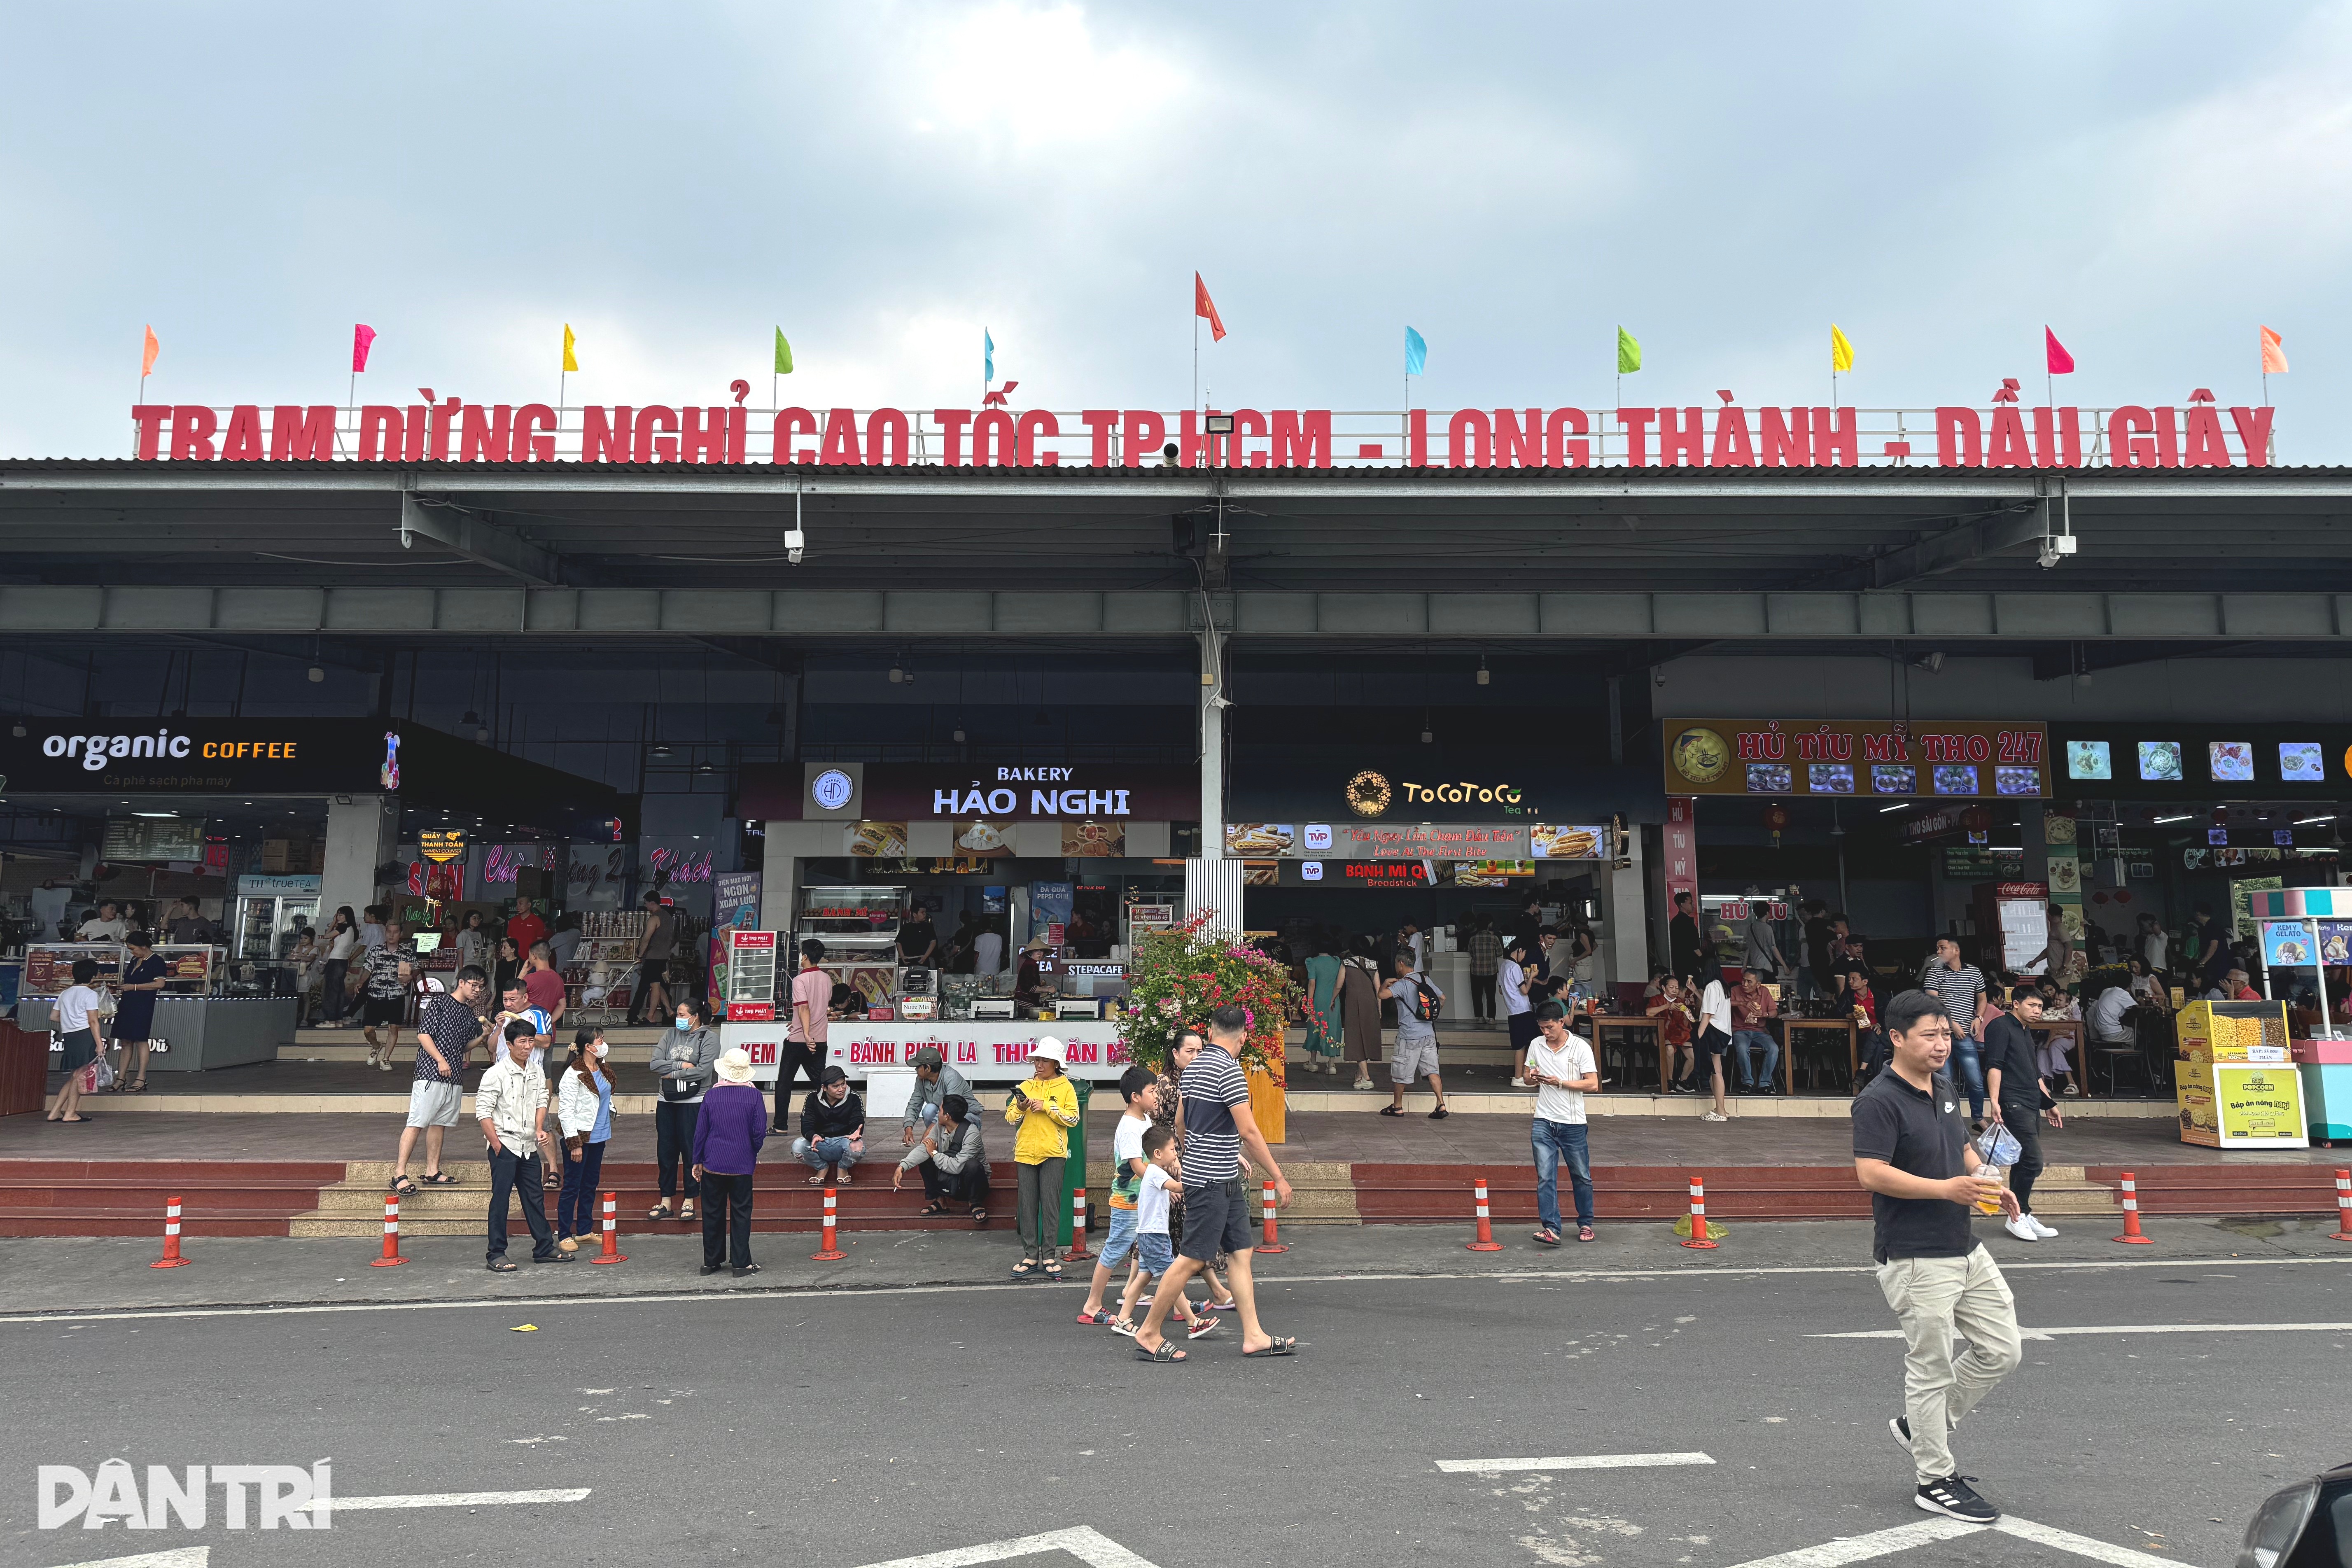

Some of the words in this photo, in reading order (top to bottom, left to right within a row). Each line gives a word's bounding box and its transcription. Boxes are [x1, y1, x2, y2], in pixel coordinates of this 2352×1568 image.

[358, 388, 556, 463] DỪNG
[583, 379, 747, 465] NGHỈ
[774, 407, 909, 467] CAO
[935, 381, 1059, 467] TỐC
[1410, 407, 1589, 469] LONG
[1617, 390, 1858, 468] THÀNH
[2109, 388, 2275, 468] GIÂY
[1738, 721, 1786, 761] HỦ
[1794, 724, 1853, 761] TÍU
[1921, 734, 1990, 762] THO
[1998, 731, 2042, 762] 247
[43, 728, 191, 771] organic
[203, 742, 297, 758] COFFEE
[997, 767, 1073, 781] BAKERY
[104, 775, 120, 785] Cà
[123, 775, 145, 787] phê
[149, 775, 177, 788] sạch
[181, 775, 203, 787] pha
[205, 775, 231, 788] máy
[933, 780, 1017, 814] HẢO
[1031, 789, 1131, 815] NGHI
[1504, 805, 1521, 814] Tea
[1373, 845, 1398, 856] Love
[1416, 845, 1436, 856] The
[1465, 845, 1487, 856] Bite
[1346, 863, 1384, 877] BÁNH
[1388, 862, 1407, 877] MÌ
[723, 883, 750, 898] NGON
[2002, 882, 2041, 895] Coca-Cola
[822, 905, 852, 917] BÁNH
[1036, 961, 1053, 972] EA
[849, 1035, 897, 1064] BÁNH
[905, 1035, 950, 1064] PN
[956, 1040, 979, 1064] LA
[1065, 1037, 1099, 1063] ĂN
